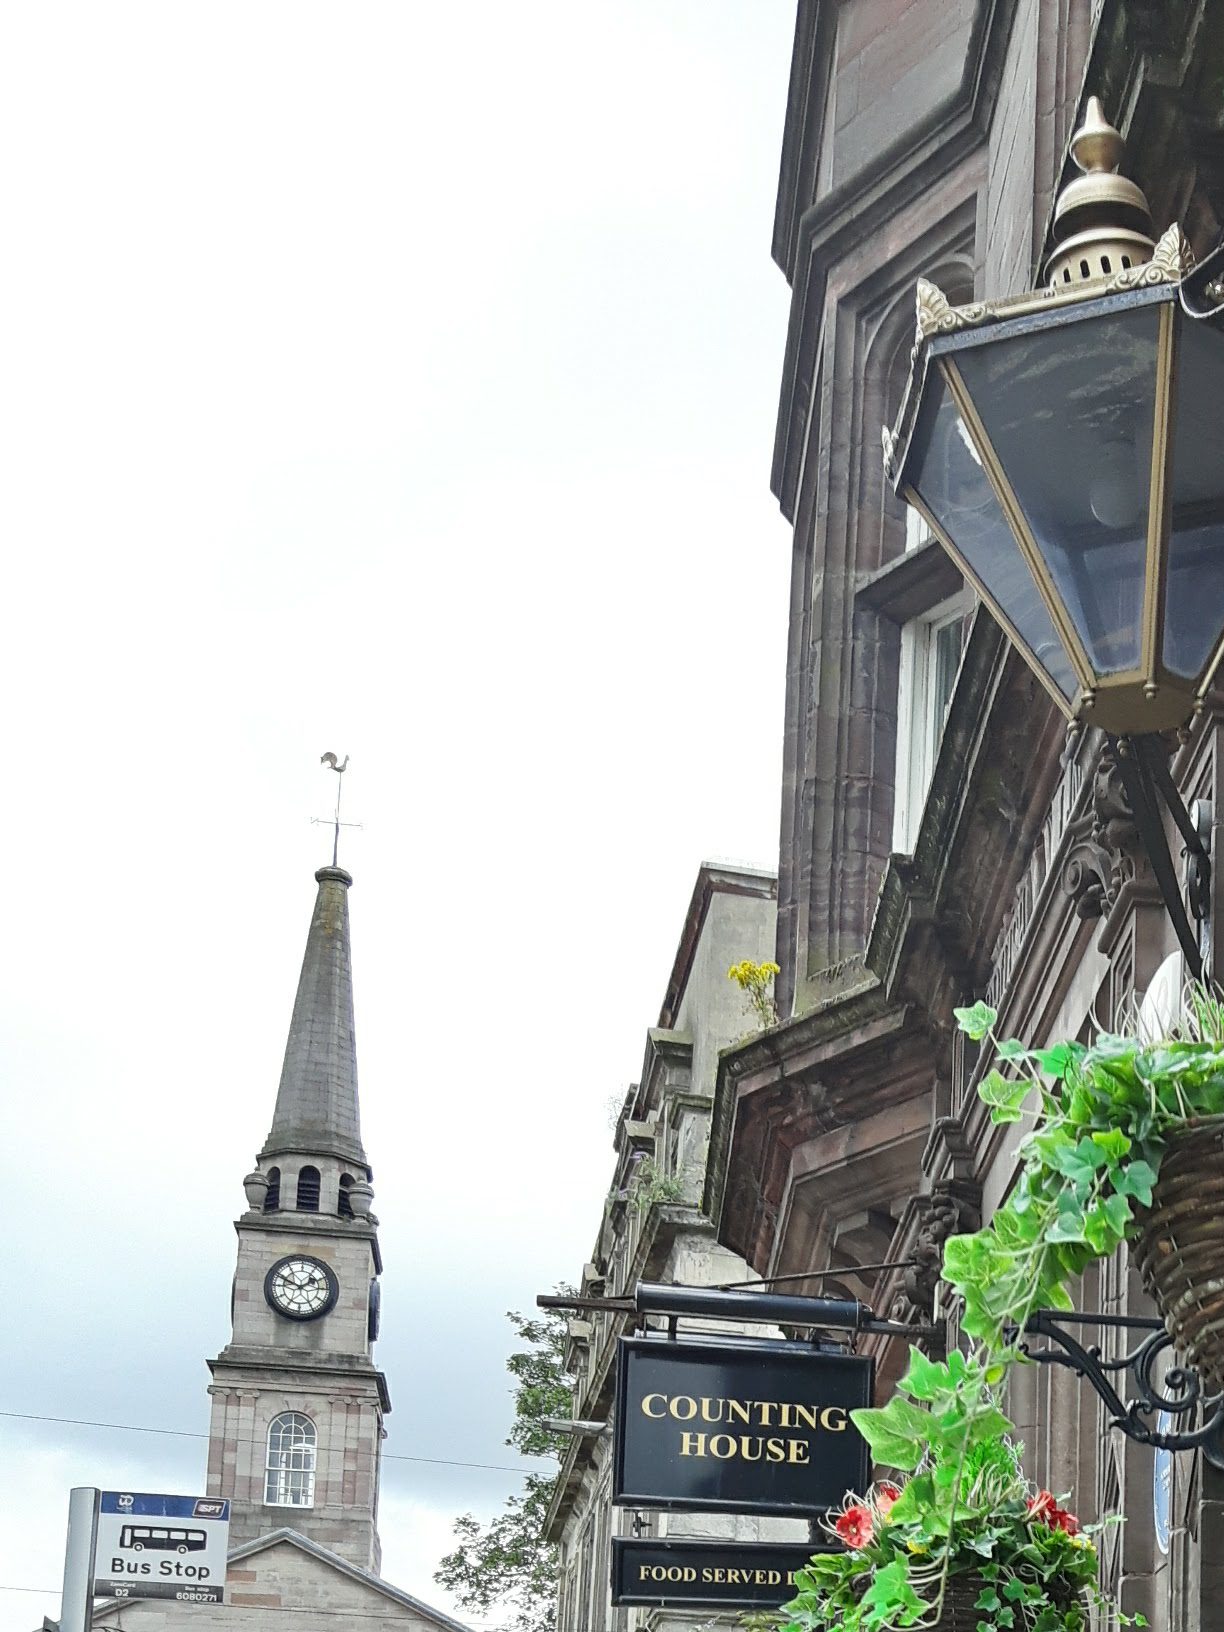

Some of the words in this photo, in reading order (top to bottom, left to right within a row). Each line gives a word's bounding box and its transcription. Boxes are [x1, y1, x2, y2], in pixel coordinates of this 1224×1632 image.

[641, 1393, 849, 1432] COUNTING
[678, 1431, 811, 1465] HOUSE
[111, 1557, 151, 1575] Bus
[159, 1560, 211, 1580] Stop
[639, 1565, 697, 1583] FOOD
[702, 1567, 782, 1586] SERVED
[115, 1589, 129, 1597] D2
[176, 1592, 218, 1602] 6080271
